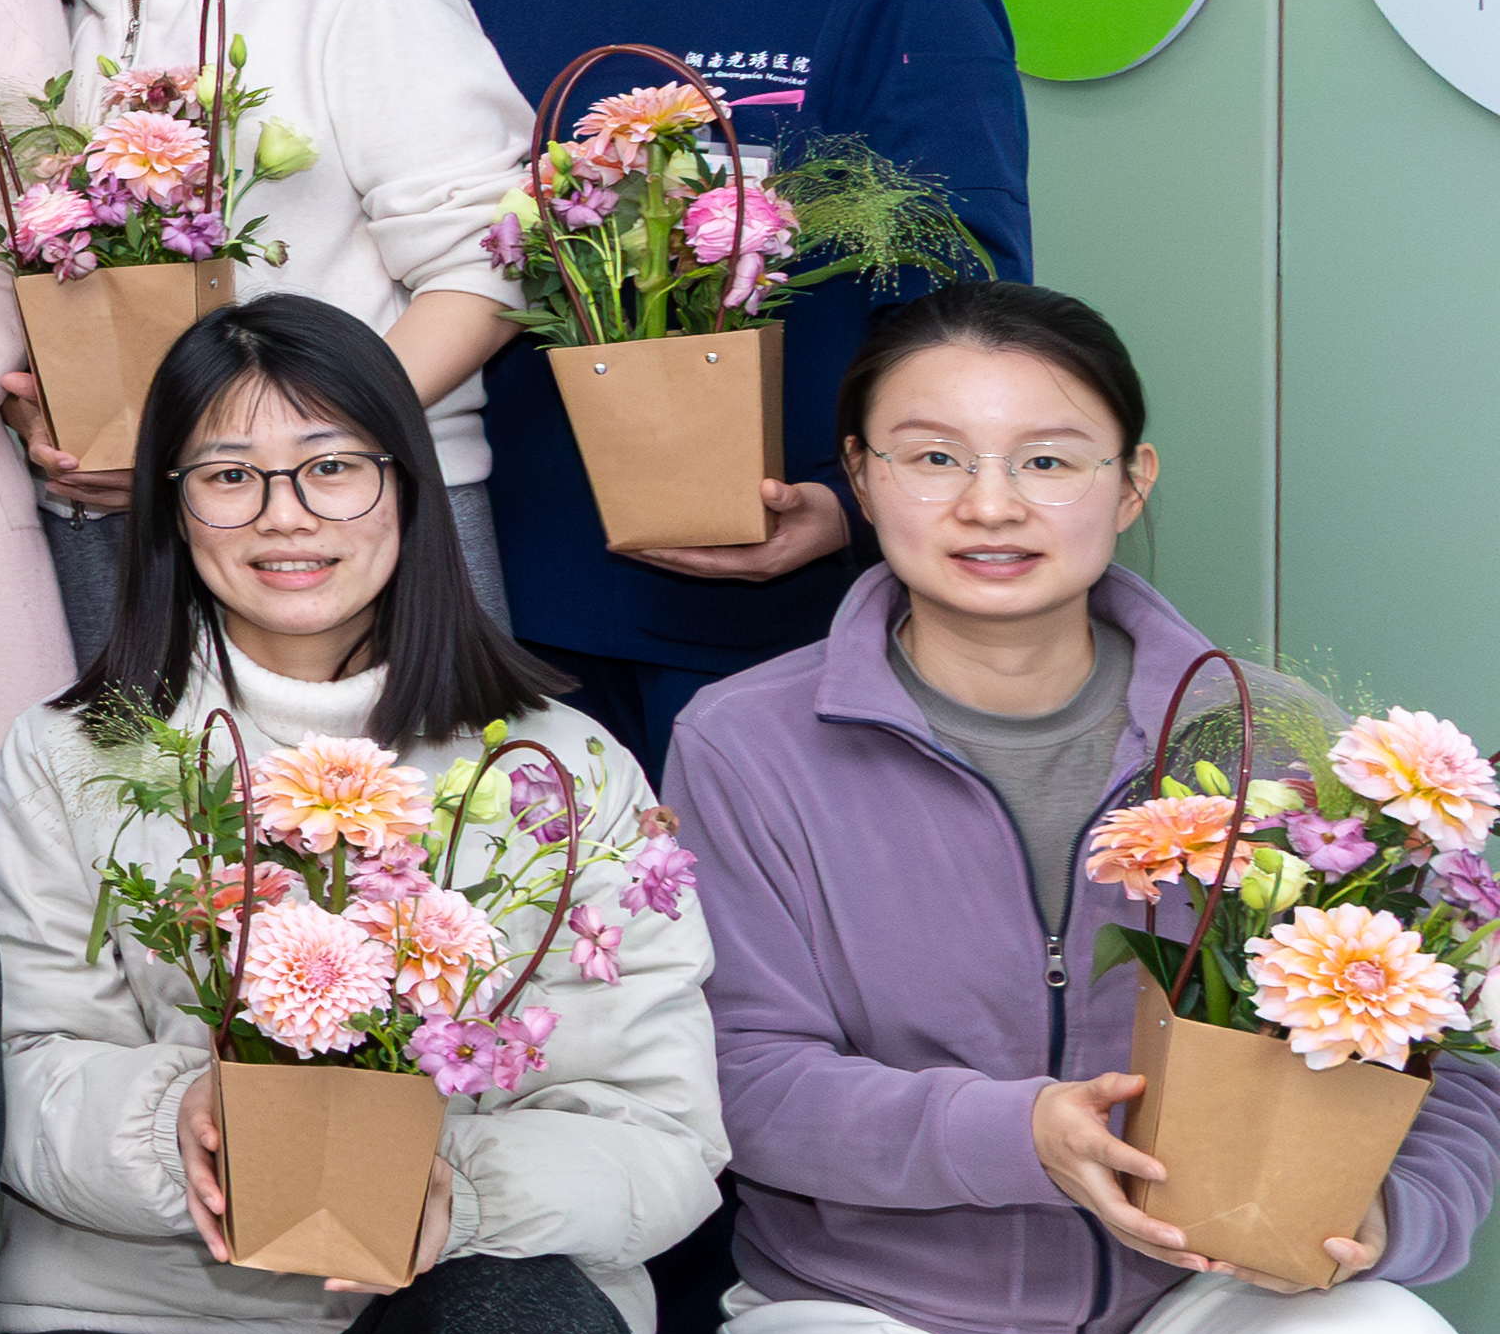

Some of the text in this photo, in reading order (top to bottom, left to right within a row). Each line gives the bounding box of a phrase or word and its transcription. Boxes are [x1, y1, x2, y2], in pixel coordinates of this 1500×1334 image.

[684, 50, 811, 73] 湖南光琇医院
